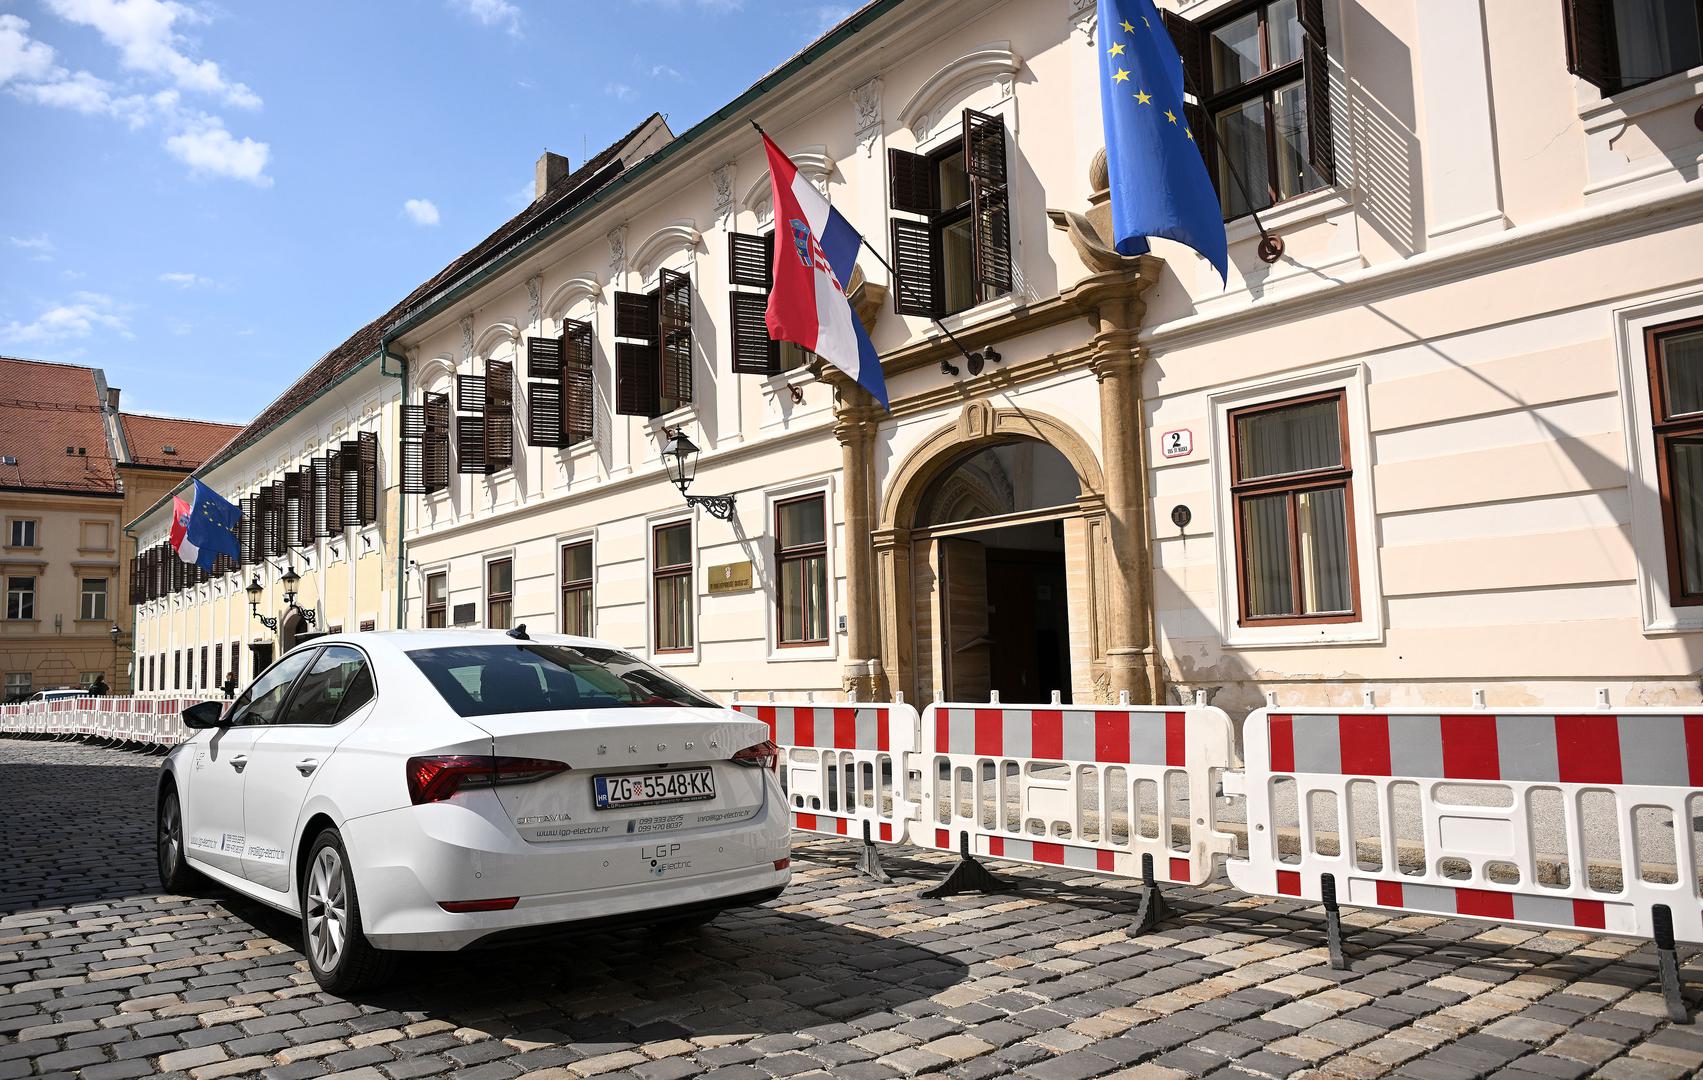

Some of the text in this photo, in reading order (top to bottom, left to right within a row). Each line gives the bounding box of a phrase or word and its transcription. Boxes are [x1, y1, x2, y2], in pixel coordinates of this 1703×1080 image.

[1171, 432, 1181, 448] 2
[608, 778, 632, 801] ZG
[598, 793, 608, 801] HR
[517, 812, 572, 825] OCTAVIA
[639, 816, 653, 825] 099
[653, 816, 666, 824] 333
[536, 825, 610, 837] www.lgp-electric.hr
[638, 822, 683, 833] 099 470 8037
[641, 843, 681, 860] LGP
[661, 860, 692, 871] Electric
